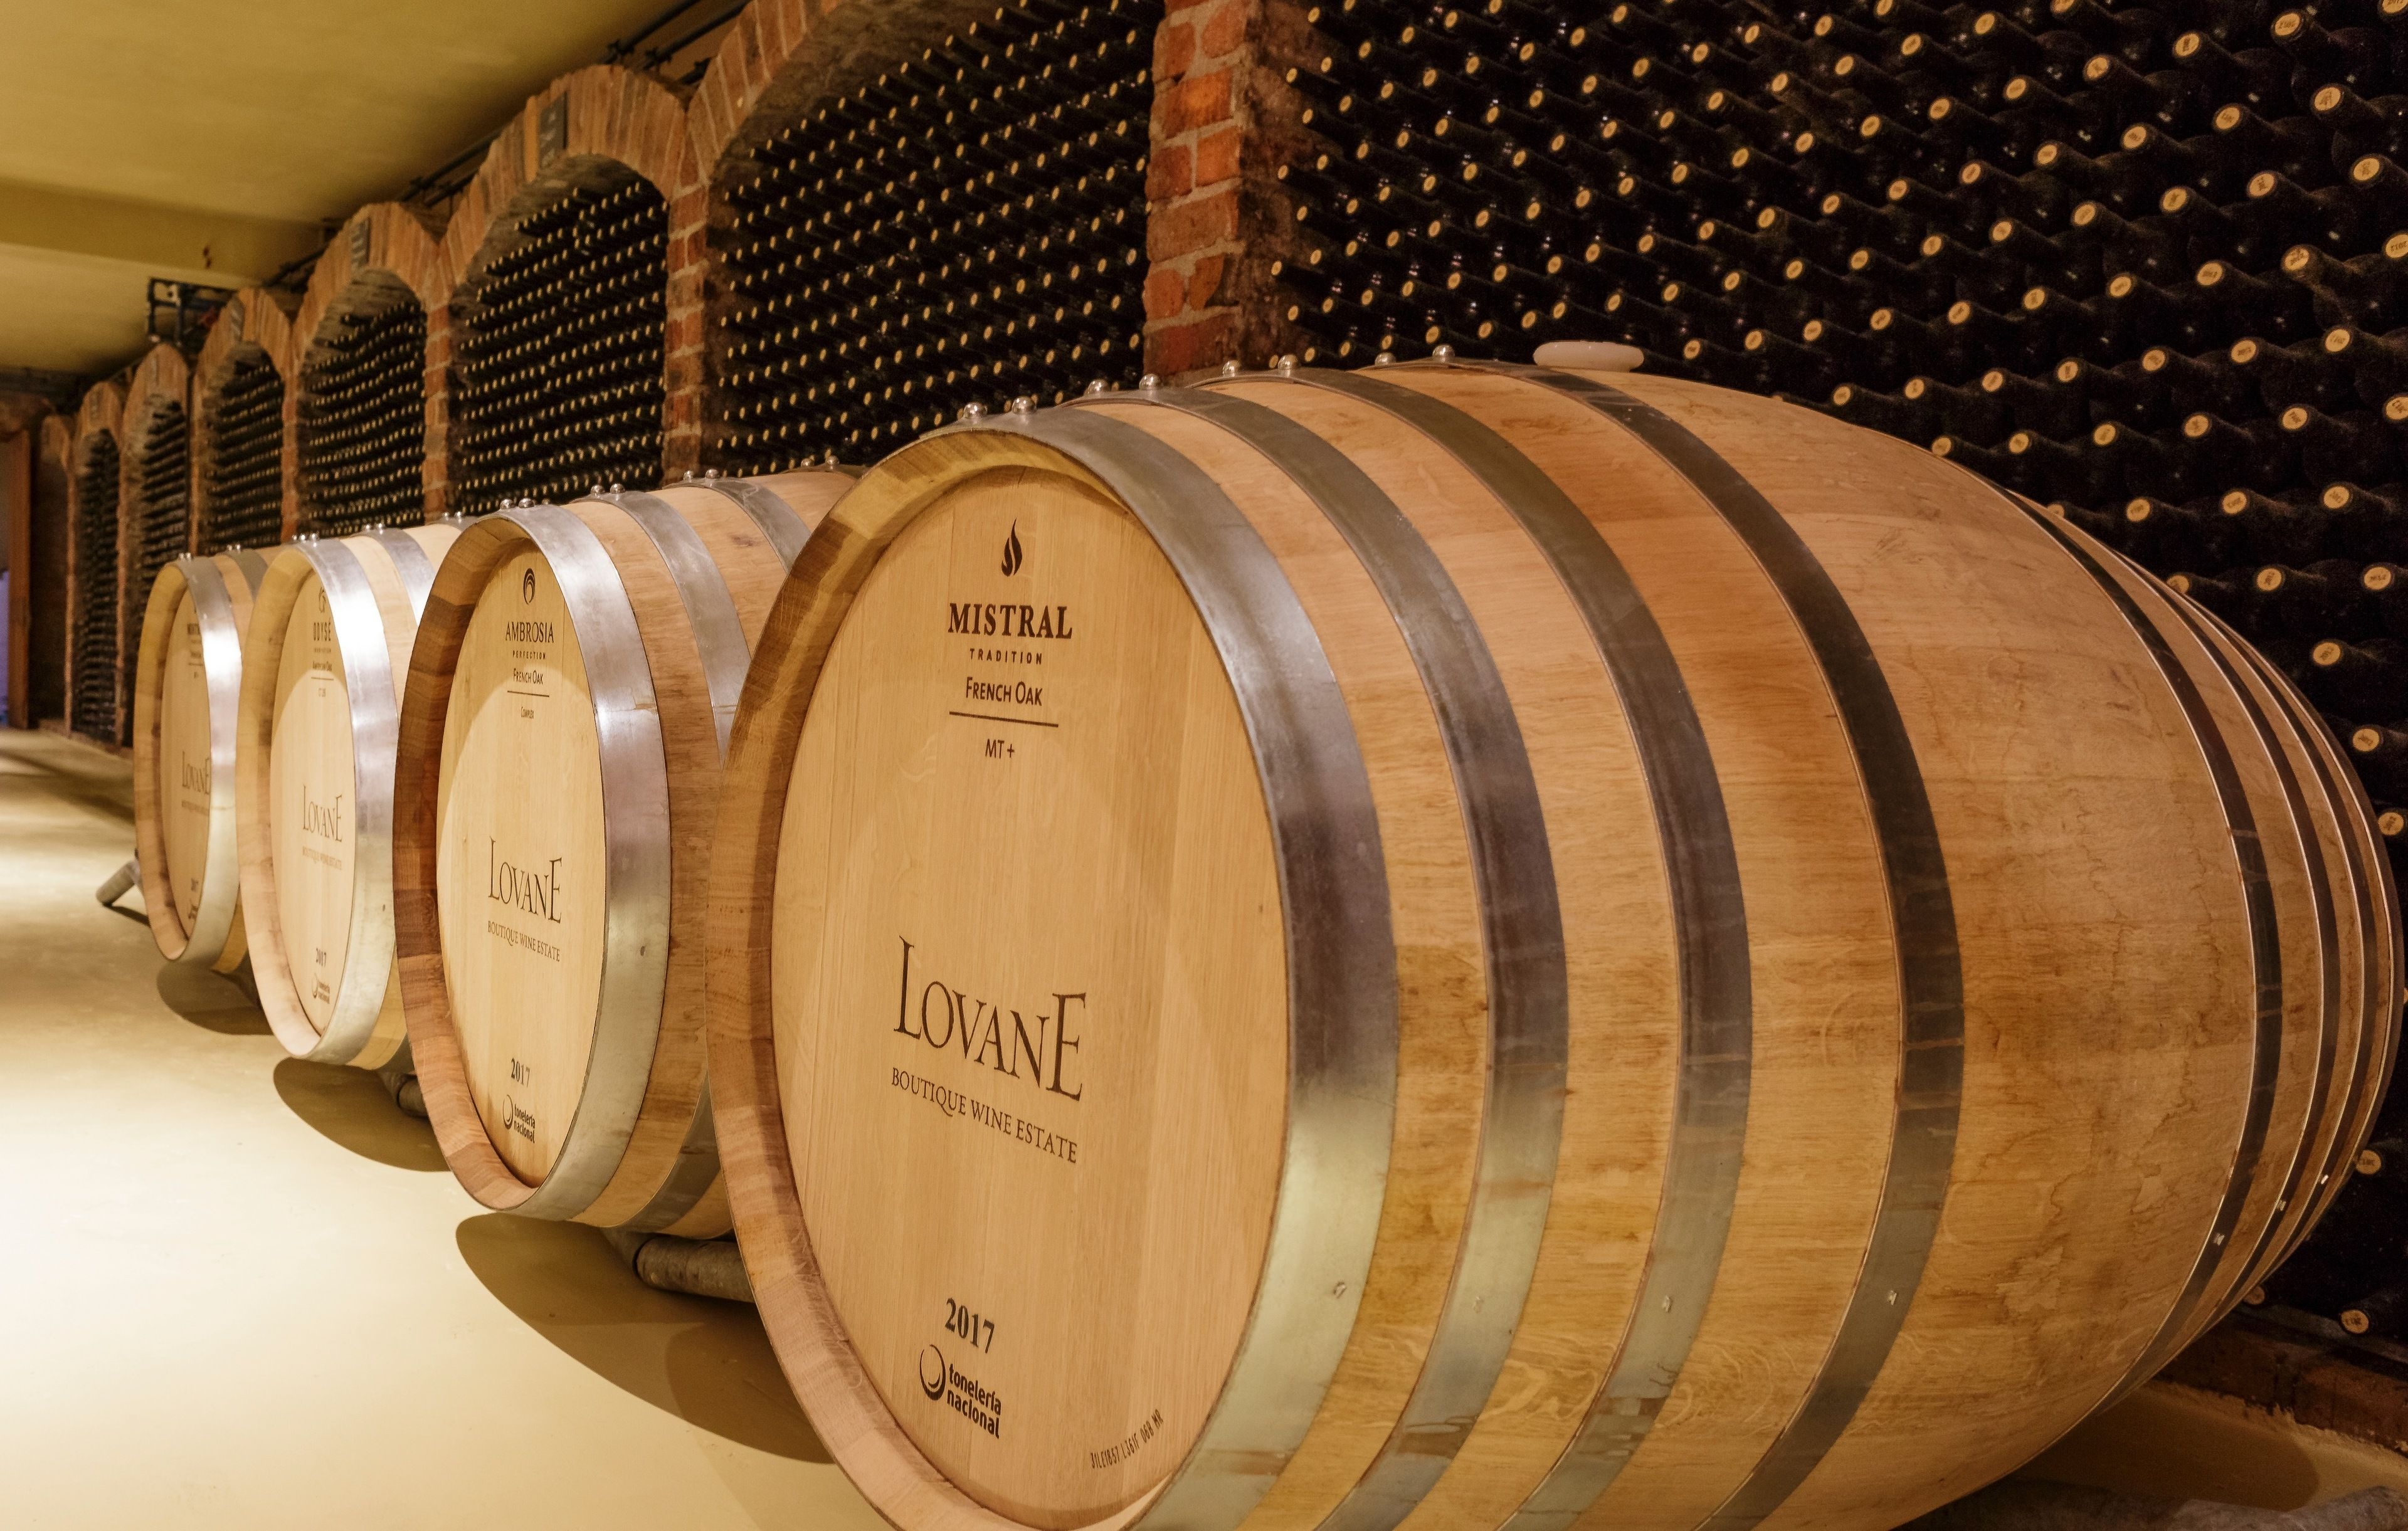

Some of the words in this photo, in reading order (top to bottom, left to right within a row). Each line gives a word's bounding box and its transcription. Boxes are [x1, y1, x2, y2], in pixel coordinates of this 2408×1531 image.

[505, 621, 554, 643] AMBROSIA
[948, 602, 1072, 639] MISTRAL
[512, 650, 546, 660] PERFECTION
[969, 648, 1042, 665] TRADITION
[303, 784, 342, 842] LOVANE
[488, 835, 562, 924] LOVANE
[488, 920, 519, 947] BOUTIQUE
[519, 932, 536, 952] WINE
[537, 940, 560, 962] ESTATE
[893, 935, 1087, 1102] LOVANE
[510, 1058, 531, 1088] 2017
[891, 1066, 966, 1117] BOUTIQUE
[970, 1098, 1012, 1135] WINE
[1015, 1118, 1077, 1164] ESTATE
[944, 1297, 995, 1354] 2017
[947, 1389, 1000, 1439] nacional
[949, 1363, 1001, 1416] tonelería
